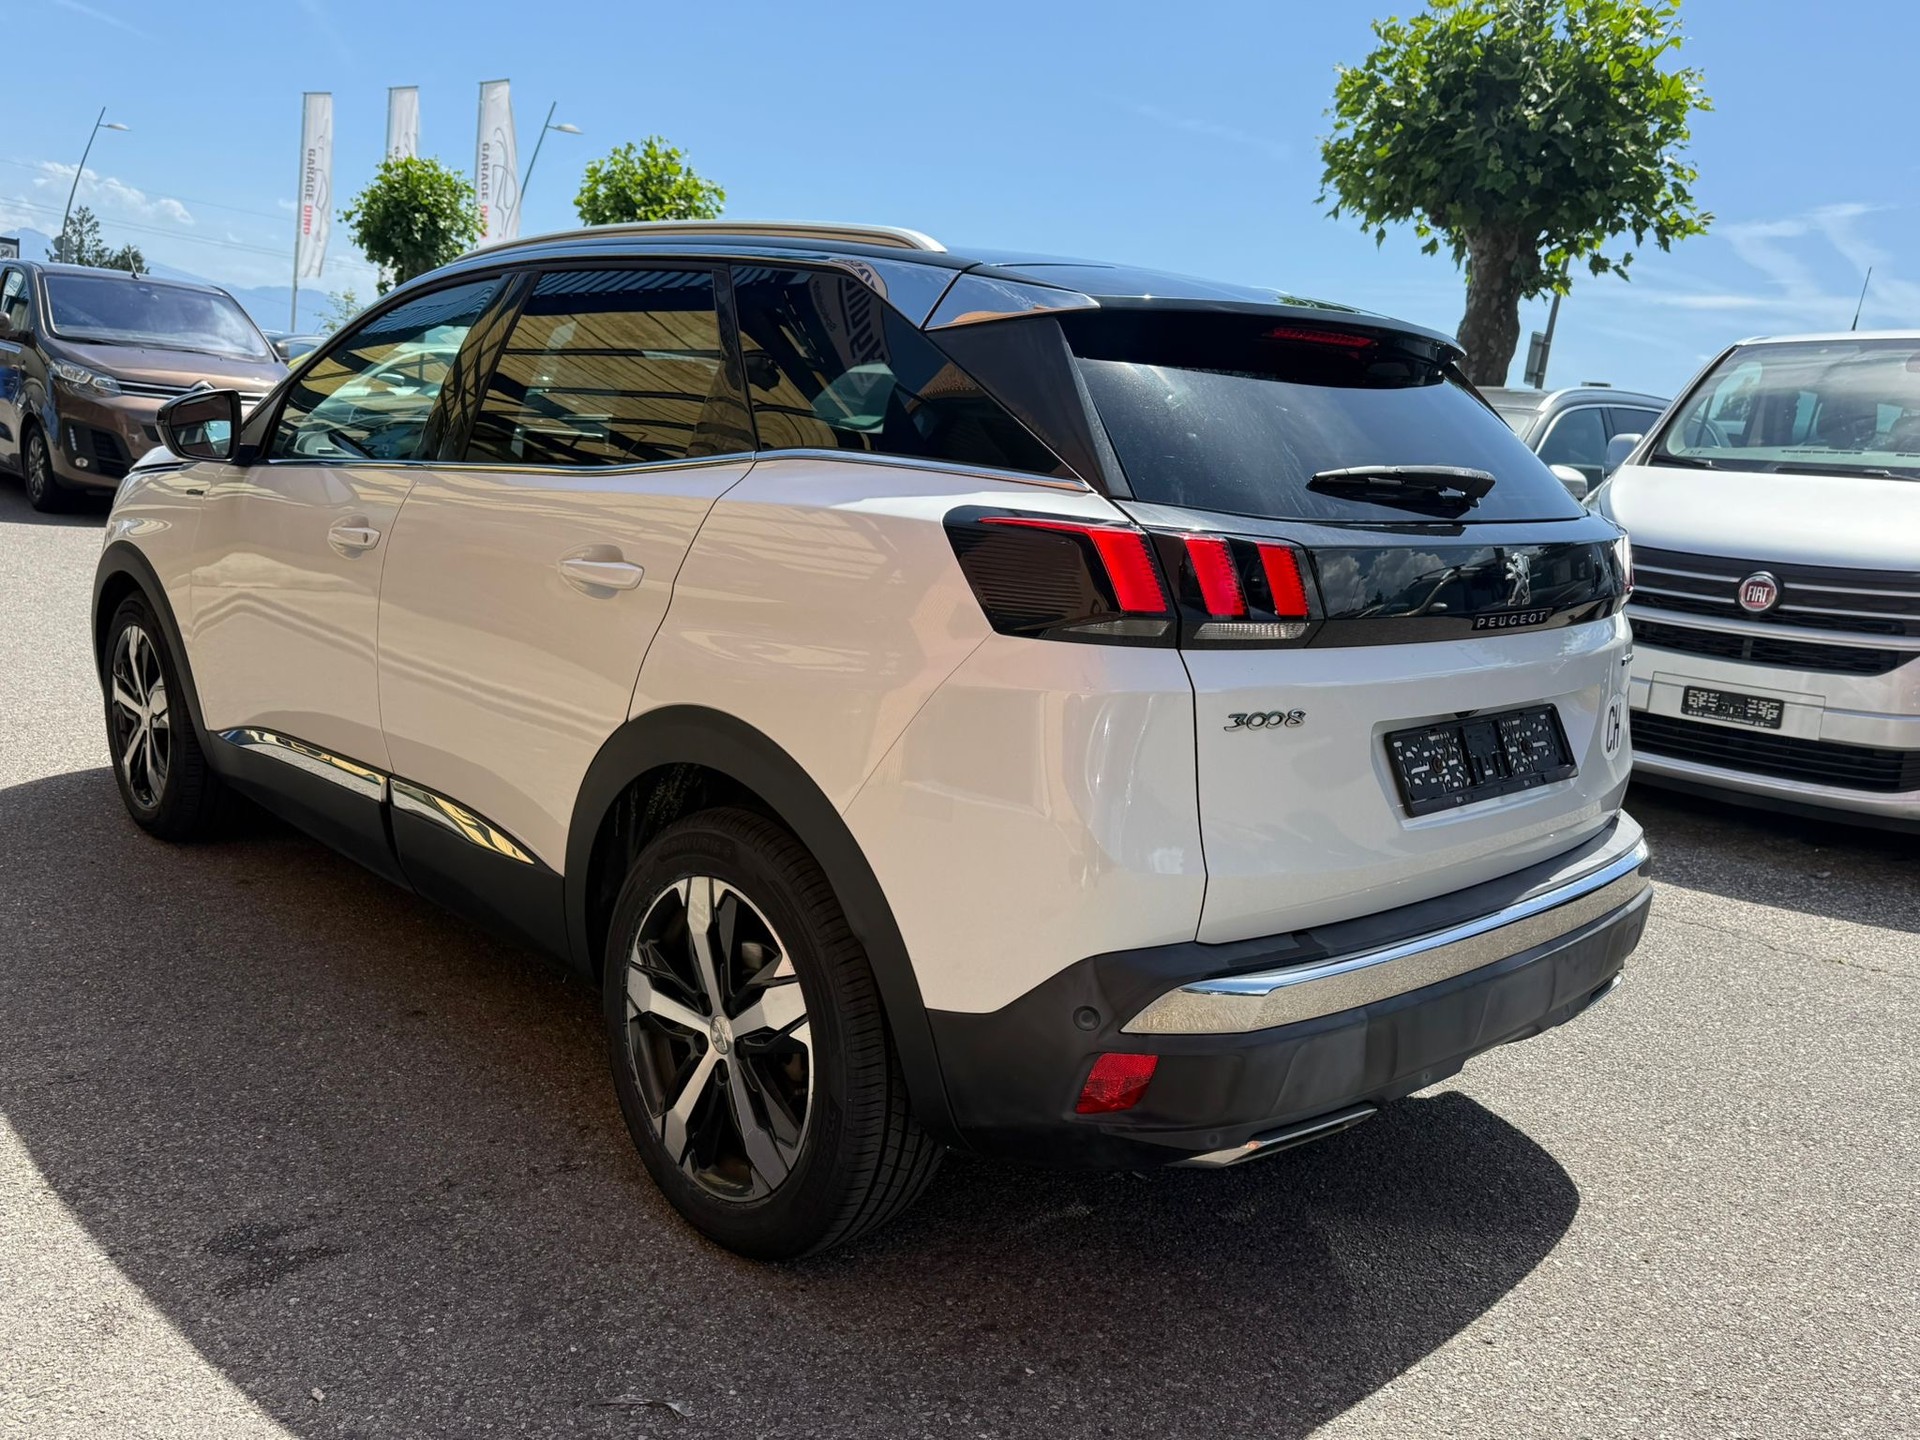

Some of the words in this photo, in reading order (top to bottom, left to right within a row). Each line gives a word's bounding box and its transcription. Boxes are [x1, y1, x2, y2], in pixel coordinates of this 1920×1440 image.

[304, 148, 316, 200] GARAGE
[481, 143, 490, 200] GARAGE
[303, 204, 313, 236] DINO
[1746, 585, 1770, 603] FIAT
[1476, 611, 1547, 629] PEUGEOT
[1223, 708, 1307, 732] 3008
[1606, 702, 1621, 753] CH
